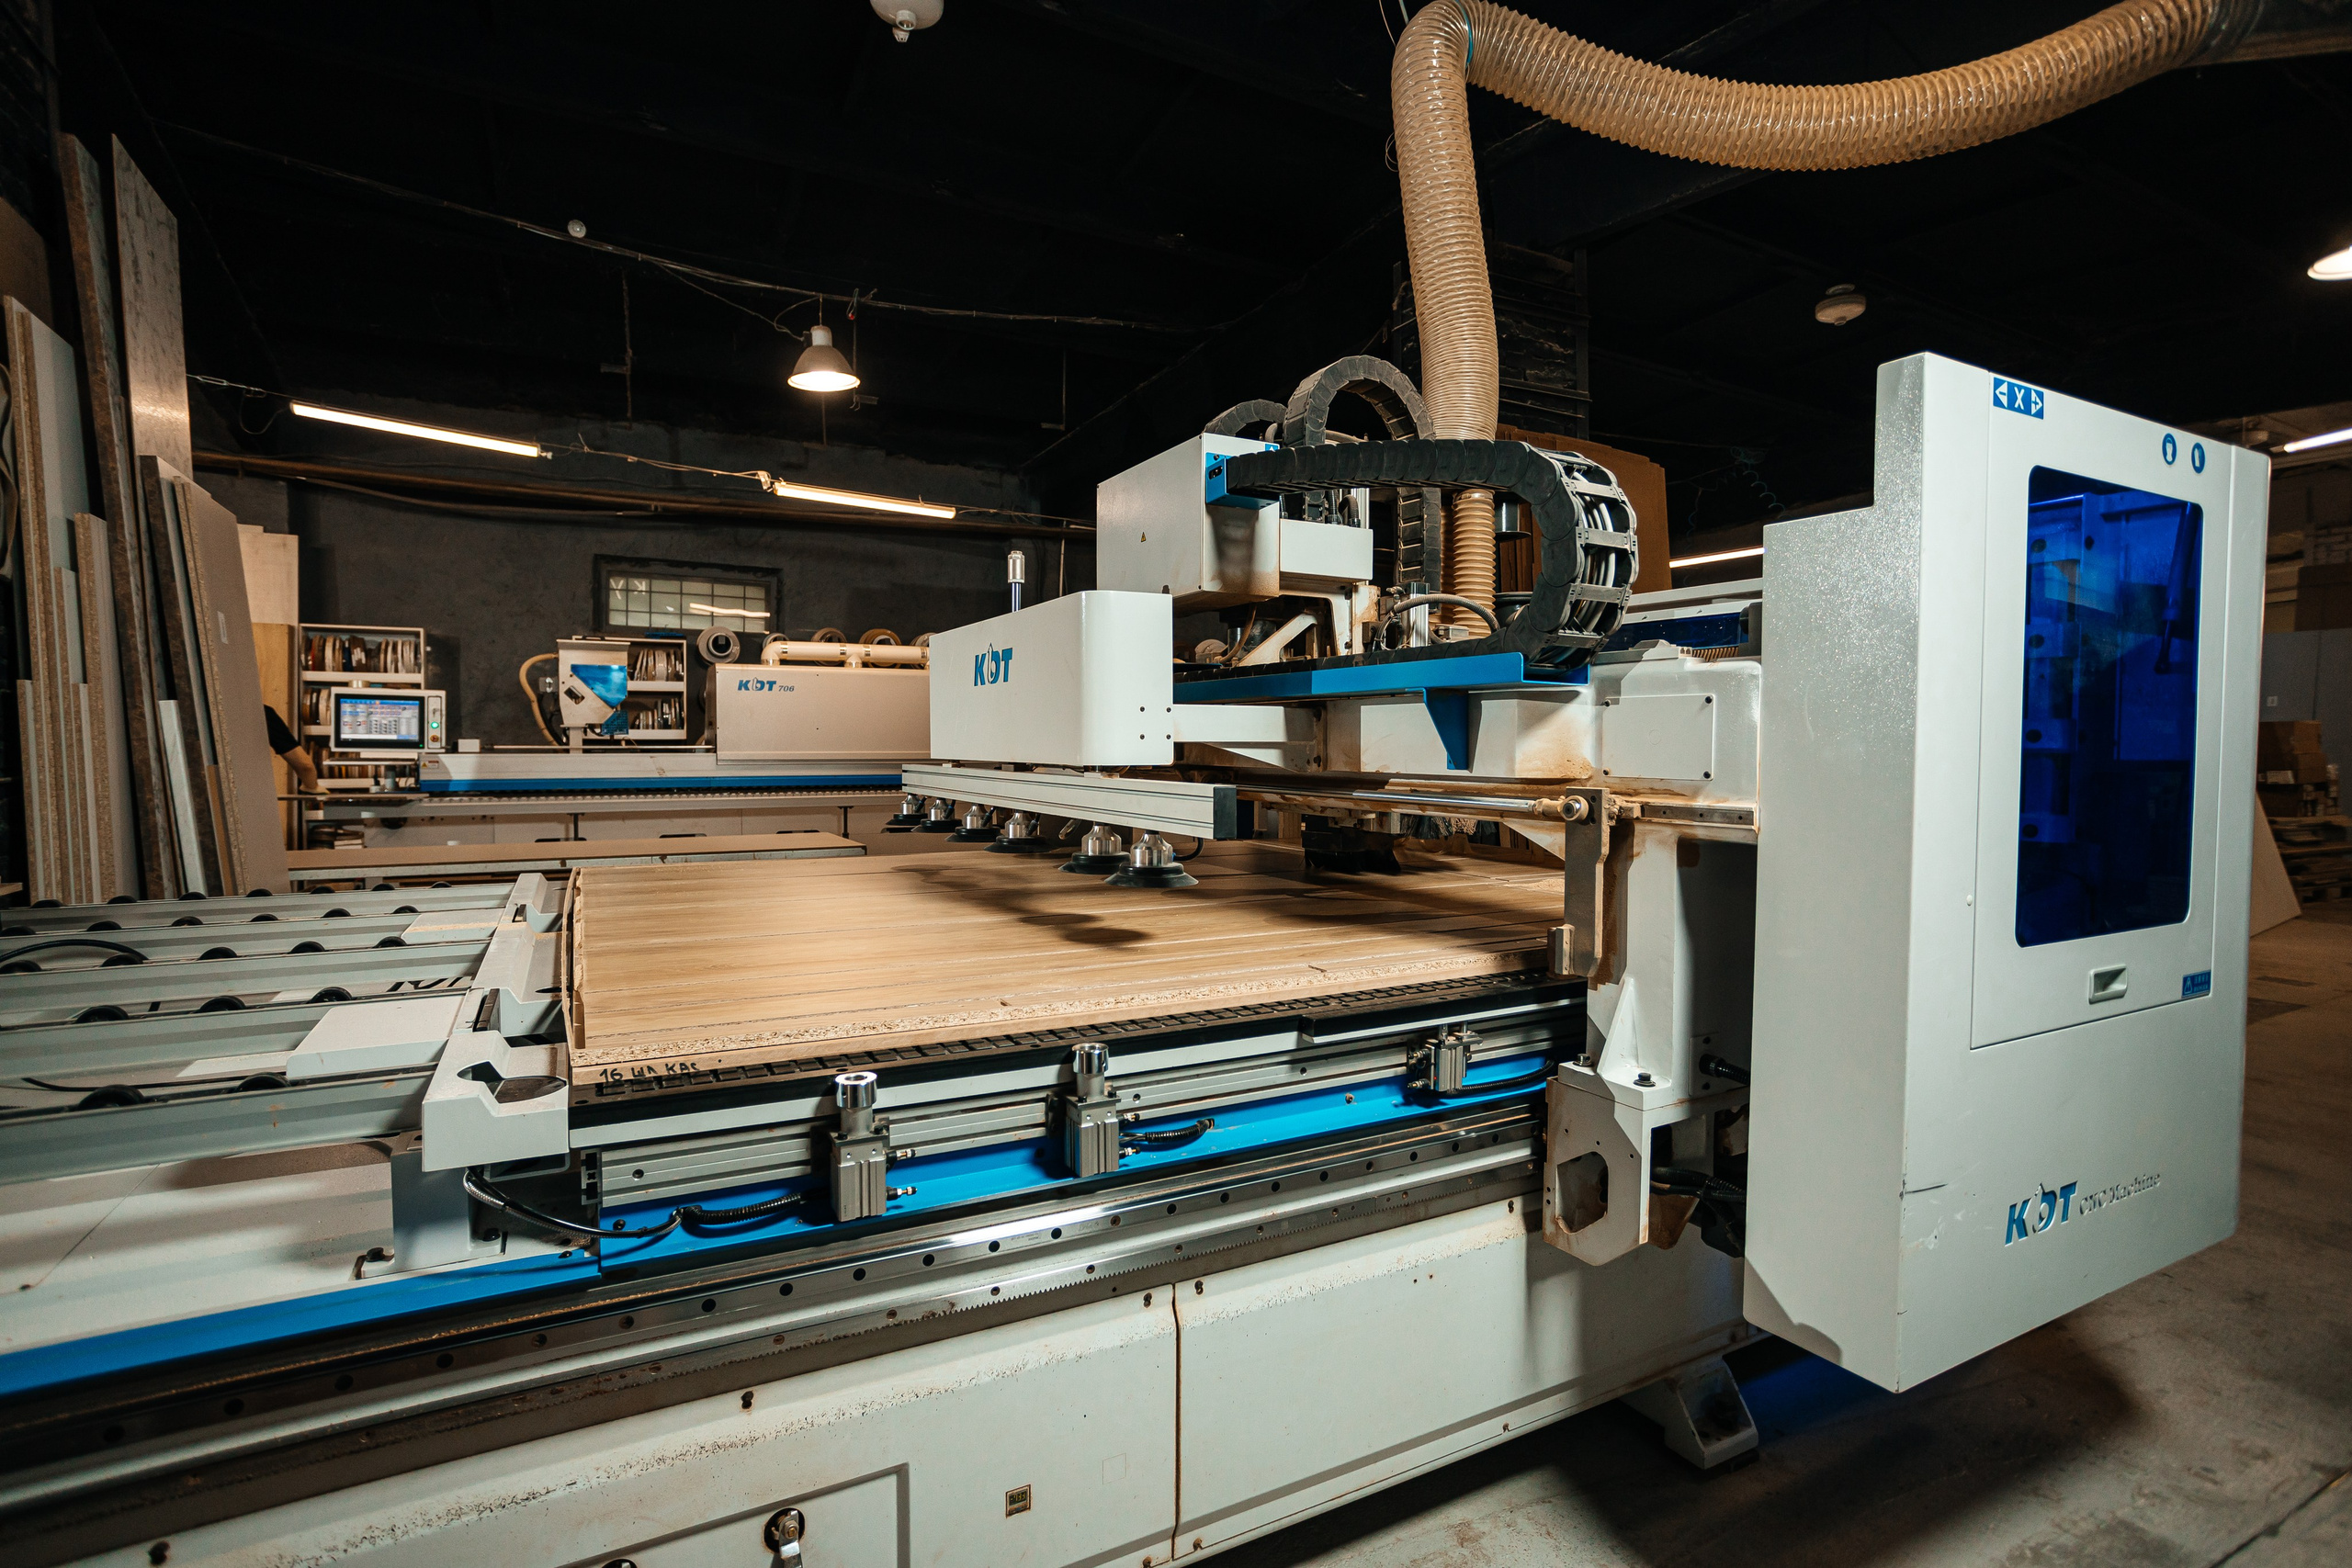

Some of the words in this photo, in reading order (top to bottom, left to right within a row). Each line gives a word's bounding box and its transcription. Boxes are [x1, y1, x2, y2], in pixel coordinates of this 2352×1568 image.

[974, 643, 1013, 687] KDT
[738, 677, 777, 692] KDT
[599, 1068, 623, 1083] 16
[2005, 1181, 2078, 1247] KDT
